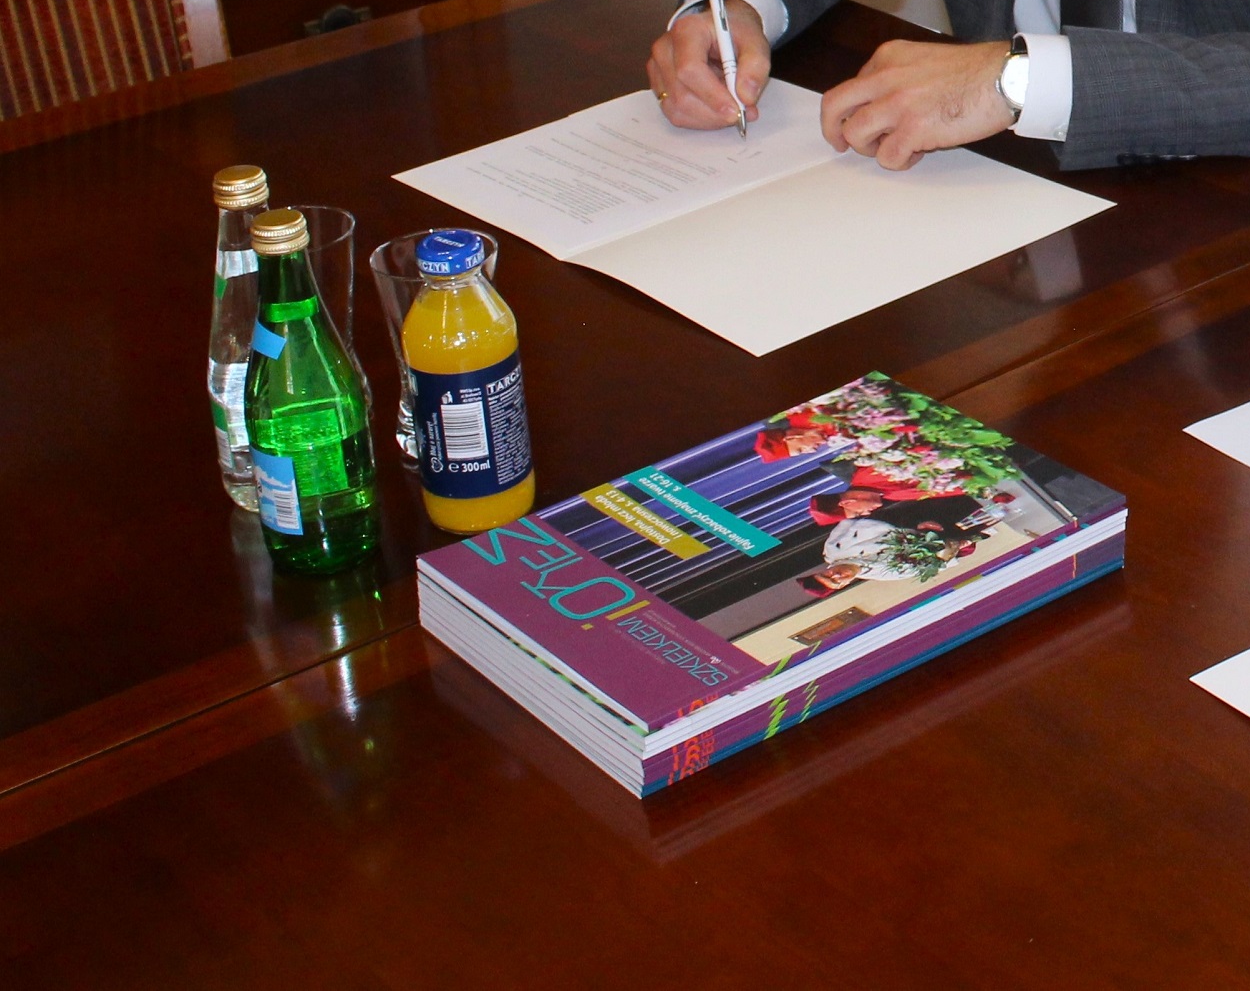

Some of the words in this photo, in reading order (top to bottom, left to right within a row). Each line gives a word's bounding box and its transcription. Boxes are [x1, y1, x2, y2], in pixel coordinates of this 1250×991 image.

[635, 476, 667, 495] twarze
[648, 472, 675, 487] 16-21
[592, 494, 623, 513] młoda
[605, 489, 628, 503] 4-13
[660, 491, 701, 515] znajome
[616, 510, 638, 522] lecz
[631, 505, 680, 536] nowoczesna
[691, 510, 735, 535] zobaczyć
[631, 519, 671, 544] Dostojna,
[723, 530, 758, 550] Fajnie
[615, 615, 730, 686] SZKIEŁKIEM
